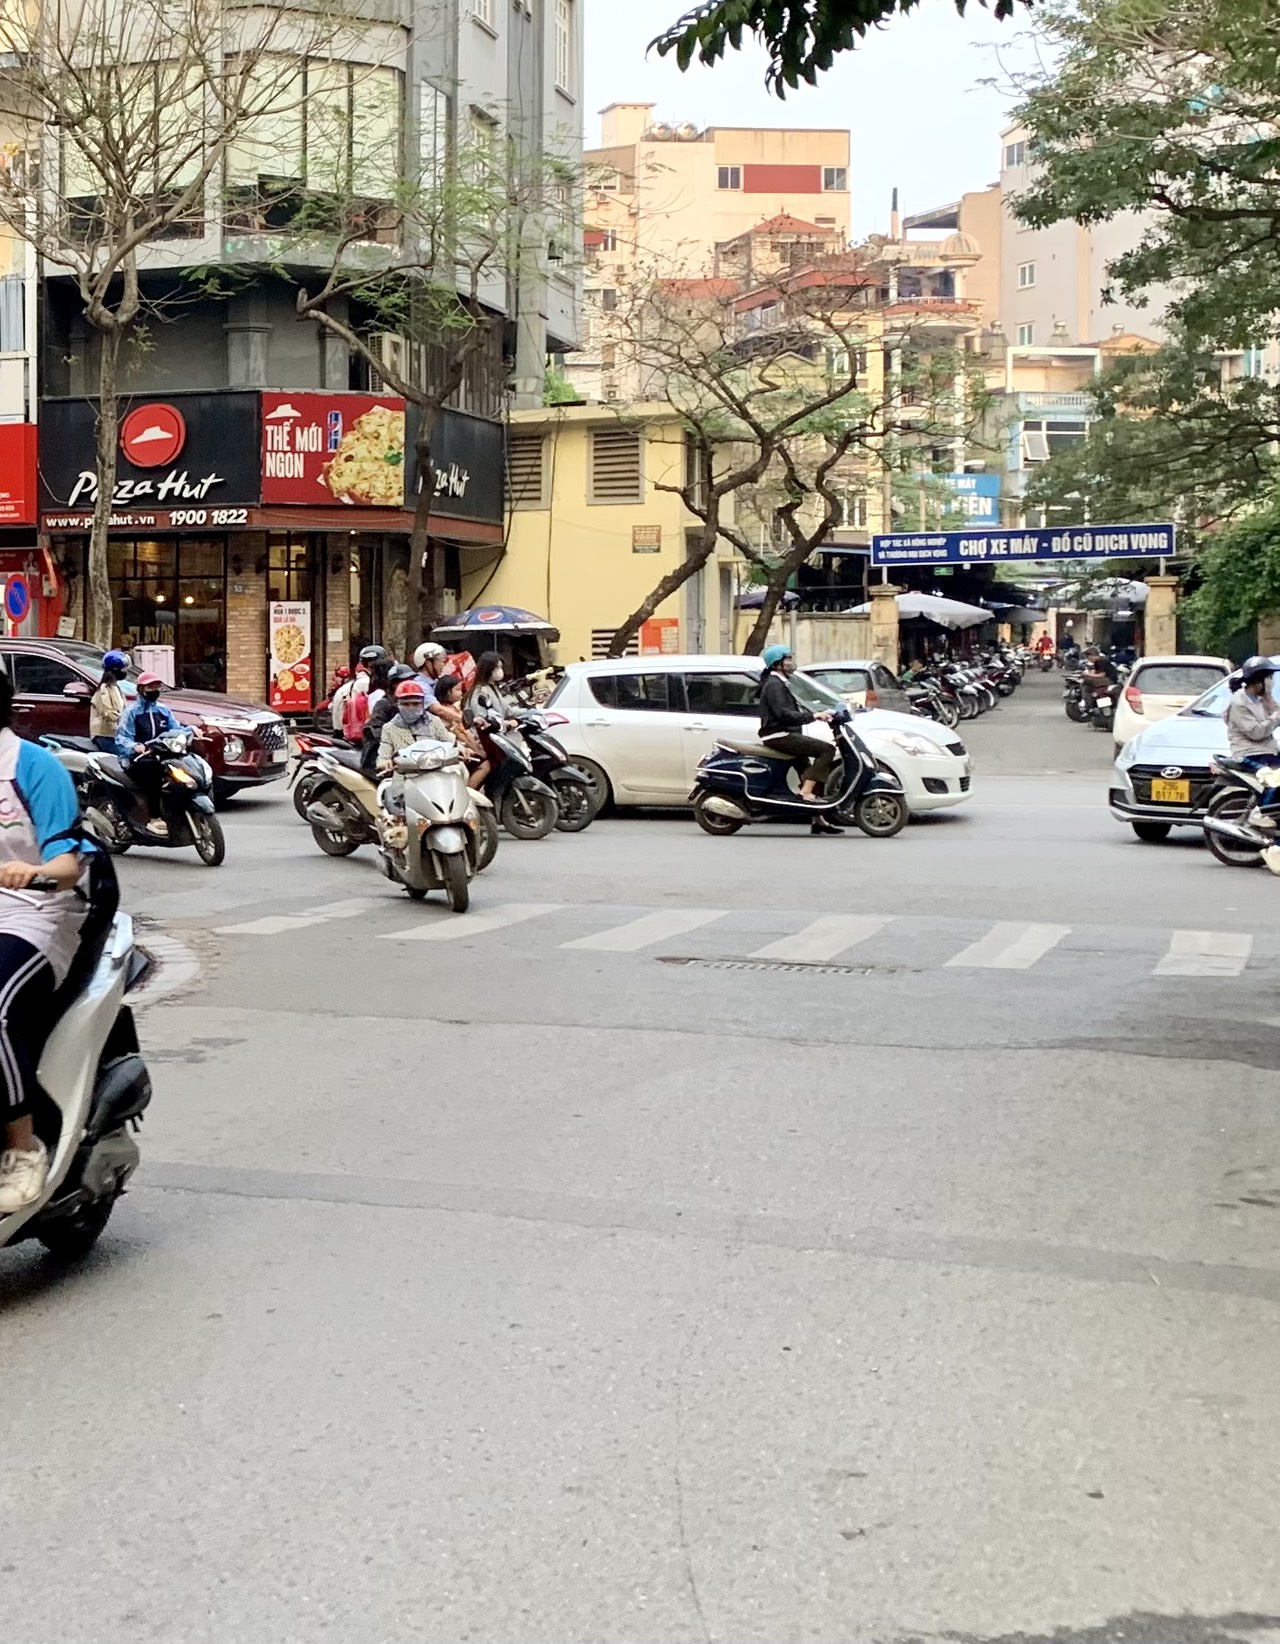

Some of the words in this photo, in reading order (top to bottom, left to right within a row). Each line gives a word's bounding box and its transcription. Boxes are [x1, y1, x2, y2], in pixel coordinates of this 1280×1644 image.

[265, 418, 293, 451] THẾ
[295, 422, 323, 452] MỚI
[265, 452, 305, 478] NGON
[157, 469, 226, 501] Hut
[170, 509, 207, 526] 1900
[210, 509, 248, 525] 1822
[959, 538, 988, 559] CHỢ
[990, 538, 1008, 555] XE
[1010, 533, 1039, 555] MÁY
[1073, 531, 1093, 552] CŨ
[1095, 533, 1128, 554] DỊCH
[1131, 532, 1168, 553] VỌNG
